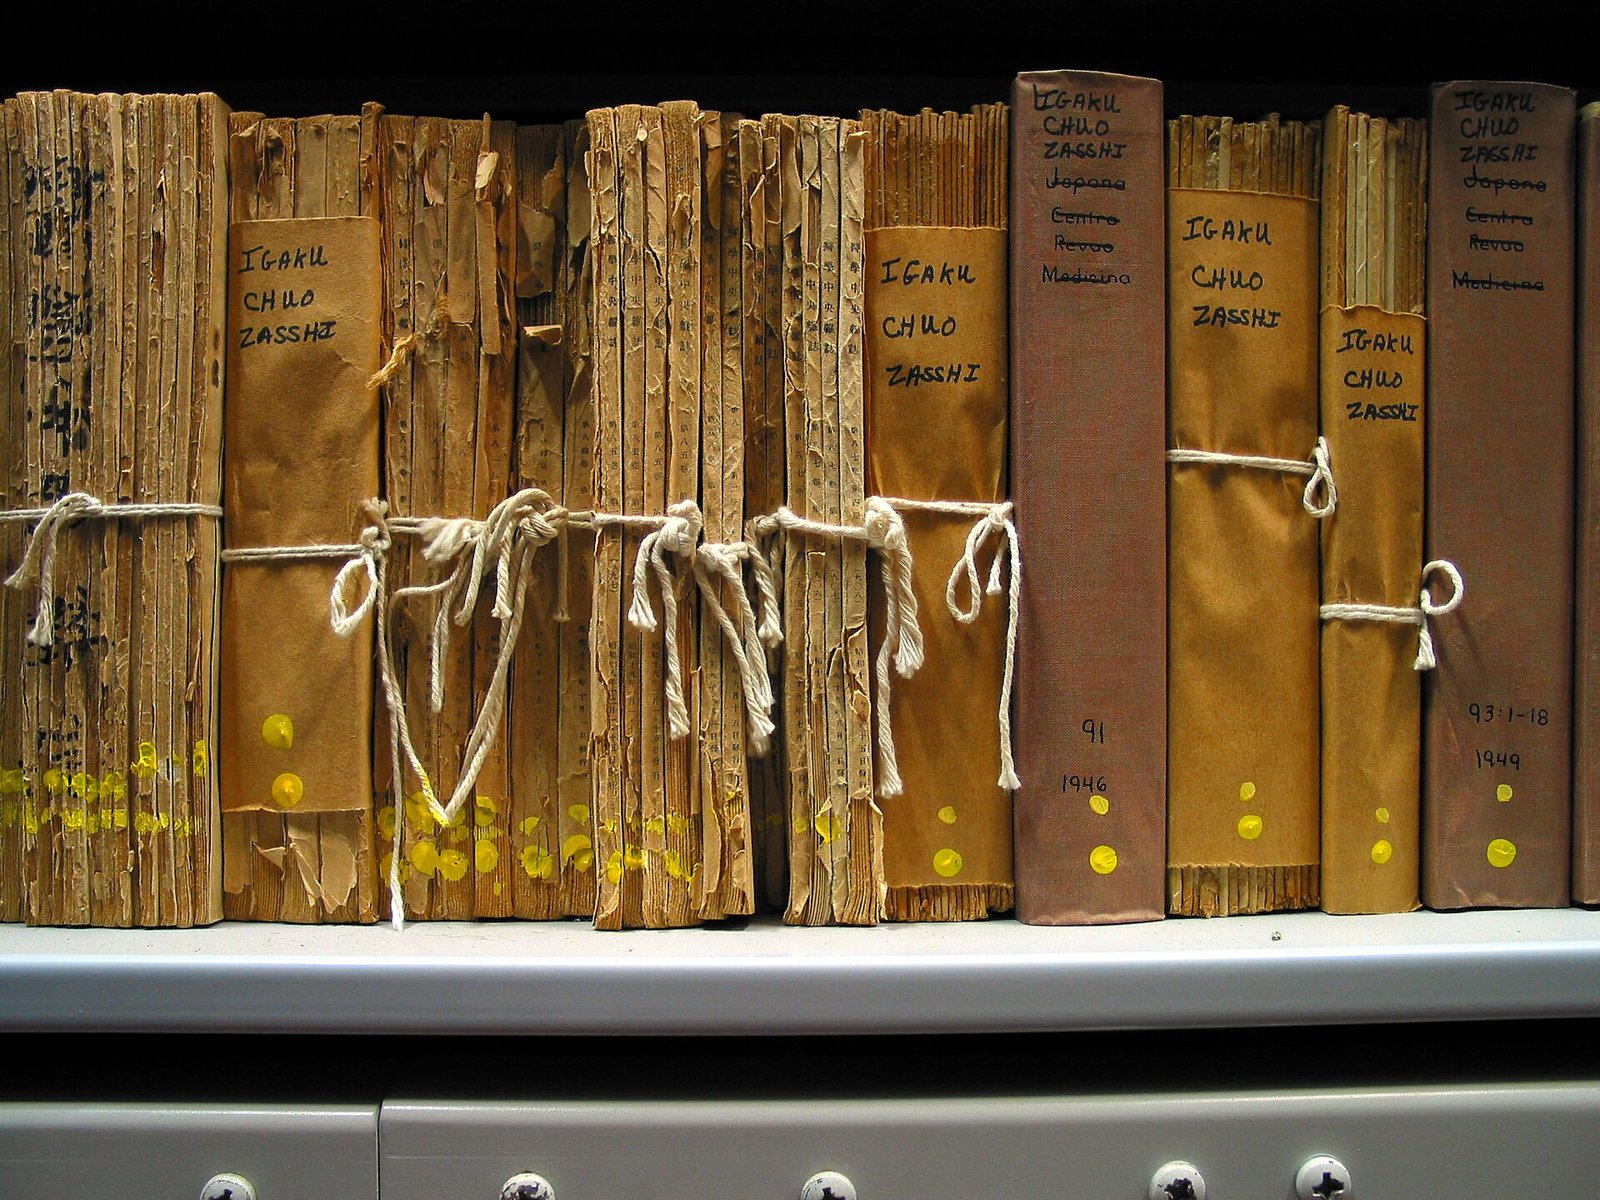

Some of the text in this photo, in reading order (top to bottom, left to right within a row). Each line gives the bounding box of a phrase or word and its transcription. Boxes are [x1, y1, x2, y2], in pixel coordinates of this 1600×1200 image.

[1033, 84, 1121, 113] IGAKU
[1454, 91, 1535, 112] IGAKU
[1043, 116, 1109, 137] CHUO
[1460, 117, 1519, 139] CHUO
[1044, 142, 1127, 160] ZASSHI
[1459, 144, 1538, 163] ZASSHI
[1182, 216, 1272, 245] IGAKU
[238, 245, 328, 274] IGAKU
[880, 257, 976, 285] IGAKU
[1191, 265, 1263, 291] CHUO
[244, 289, 315, 312] CHUO
[882, 314, 956, 338] CHUO
[1193, 305, 1281, 328] ZASSHI
[239, 321, 337, 349] ZASSHI
[1336, 328, 1414, 354] IGAKU
[885, 364, 981, 387] ZASSHI
[1344, 369, 1402, 389] CHUO
[1346, 402, 1419, 421] ZASSHI
[1082, 718, 1104, 744] 91
[1476, 749, 1520, 772] 1949
[1062, 774, 1107, 793] 1946
